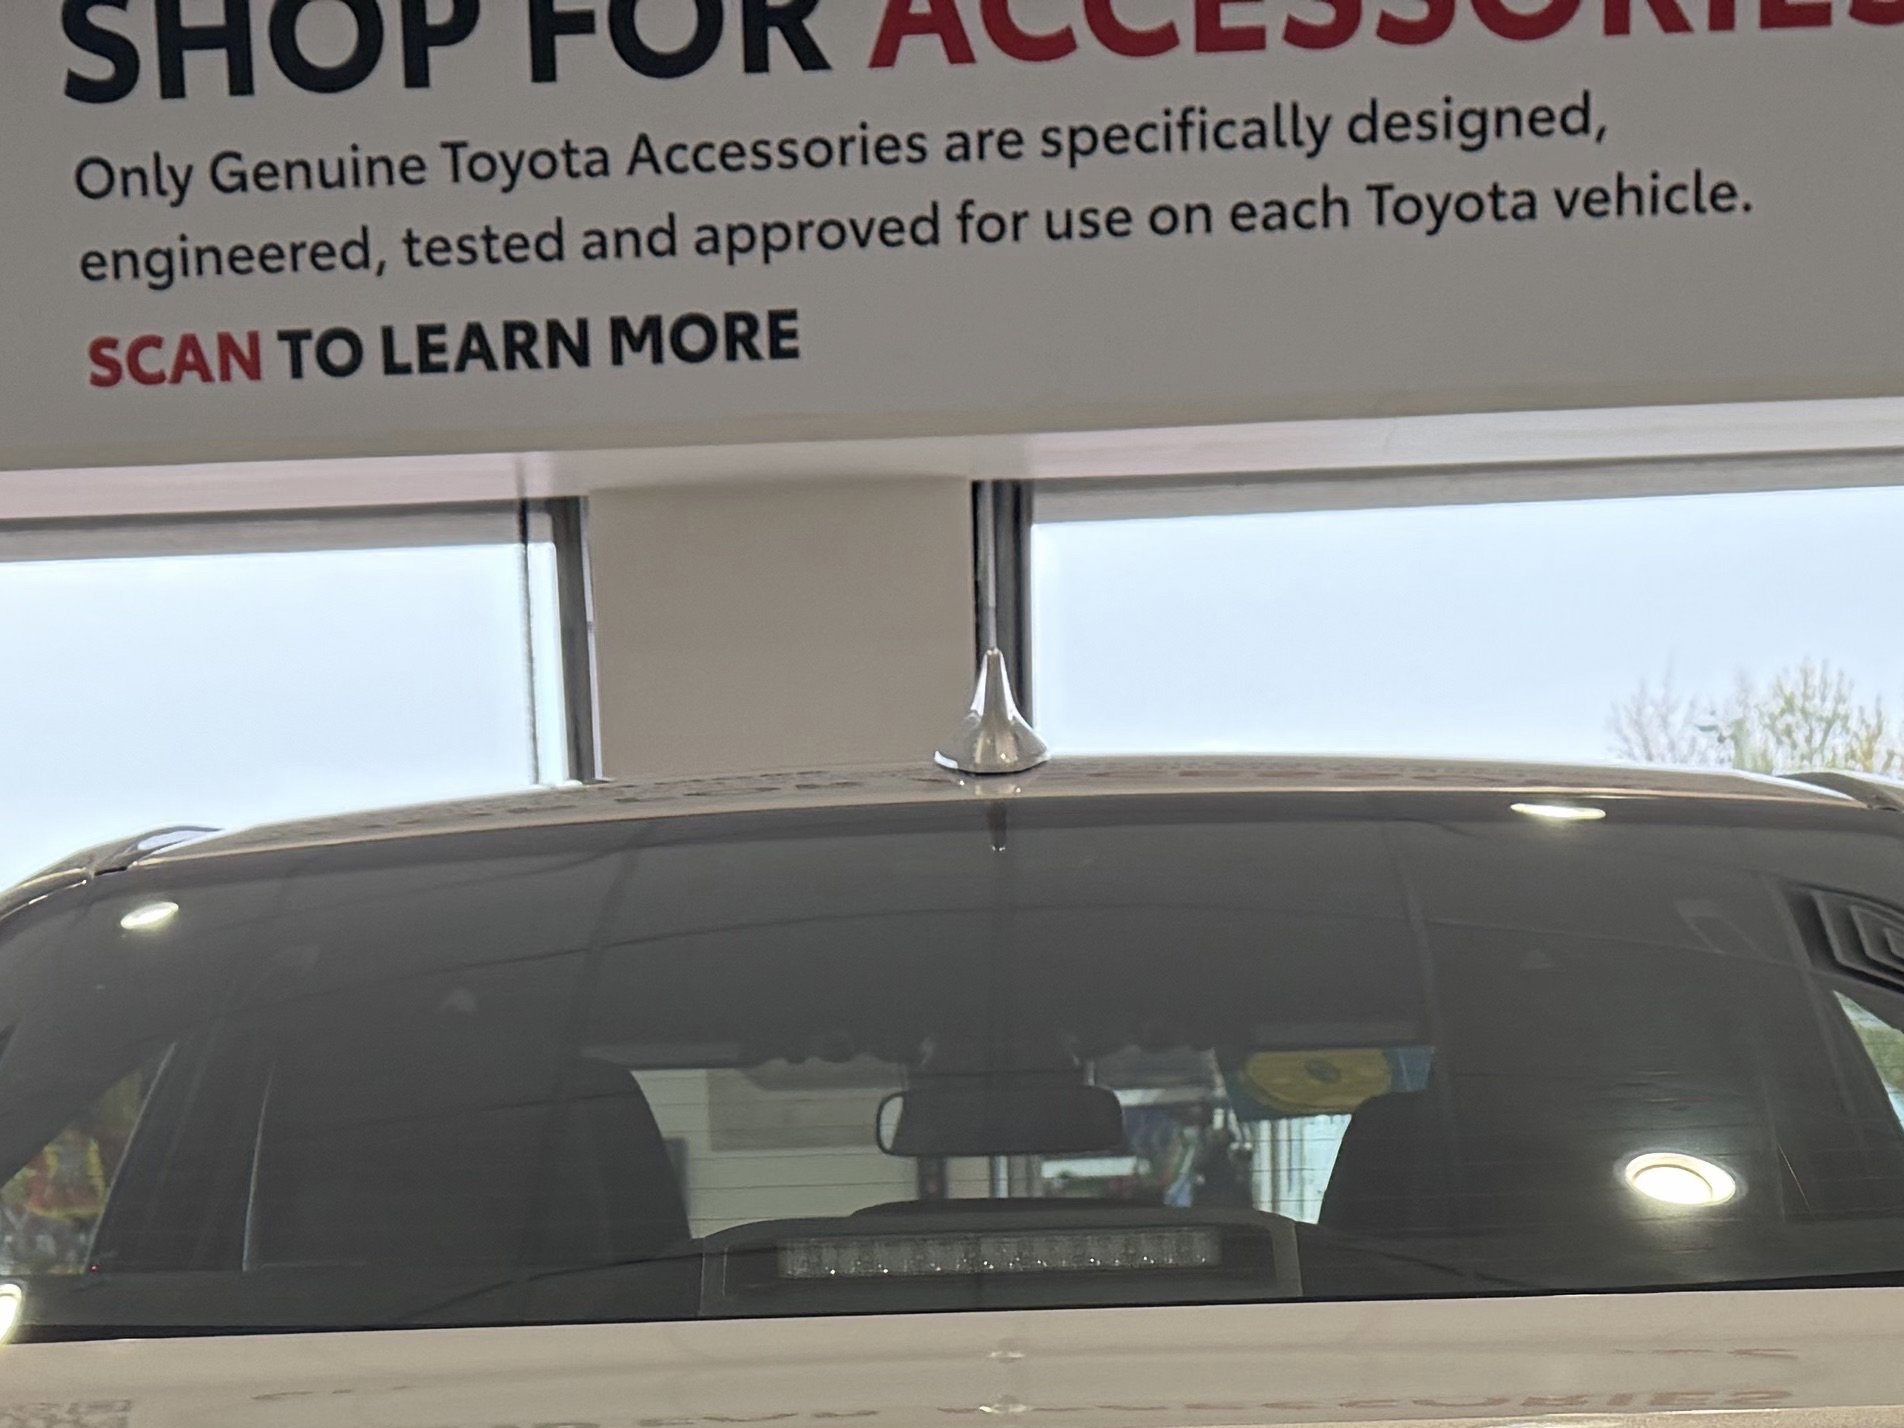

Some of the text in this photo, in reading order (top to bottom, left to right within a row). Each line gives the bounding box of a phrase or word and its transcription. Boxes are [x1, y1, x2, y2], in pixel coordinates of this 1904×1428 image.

[62, 0, 480, 104] SHOP
[529, 0, 831, 83] FOR
[75, 90, 1610, 208] Only Genuine Toyota Accessories are specifically designed,
[79, 167, 1754, 291] engineered, tested and approved for use on each Toyota vehicle.
[87, 309, 801, 388] SCAN TO LEARN MORE
